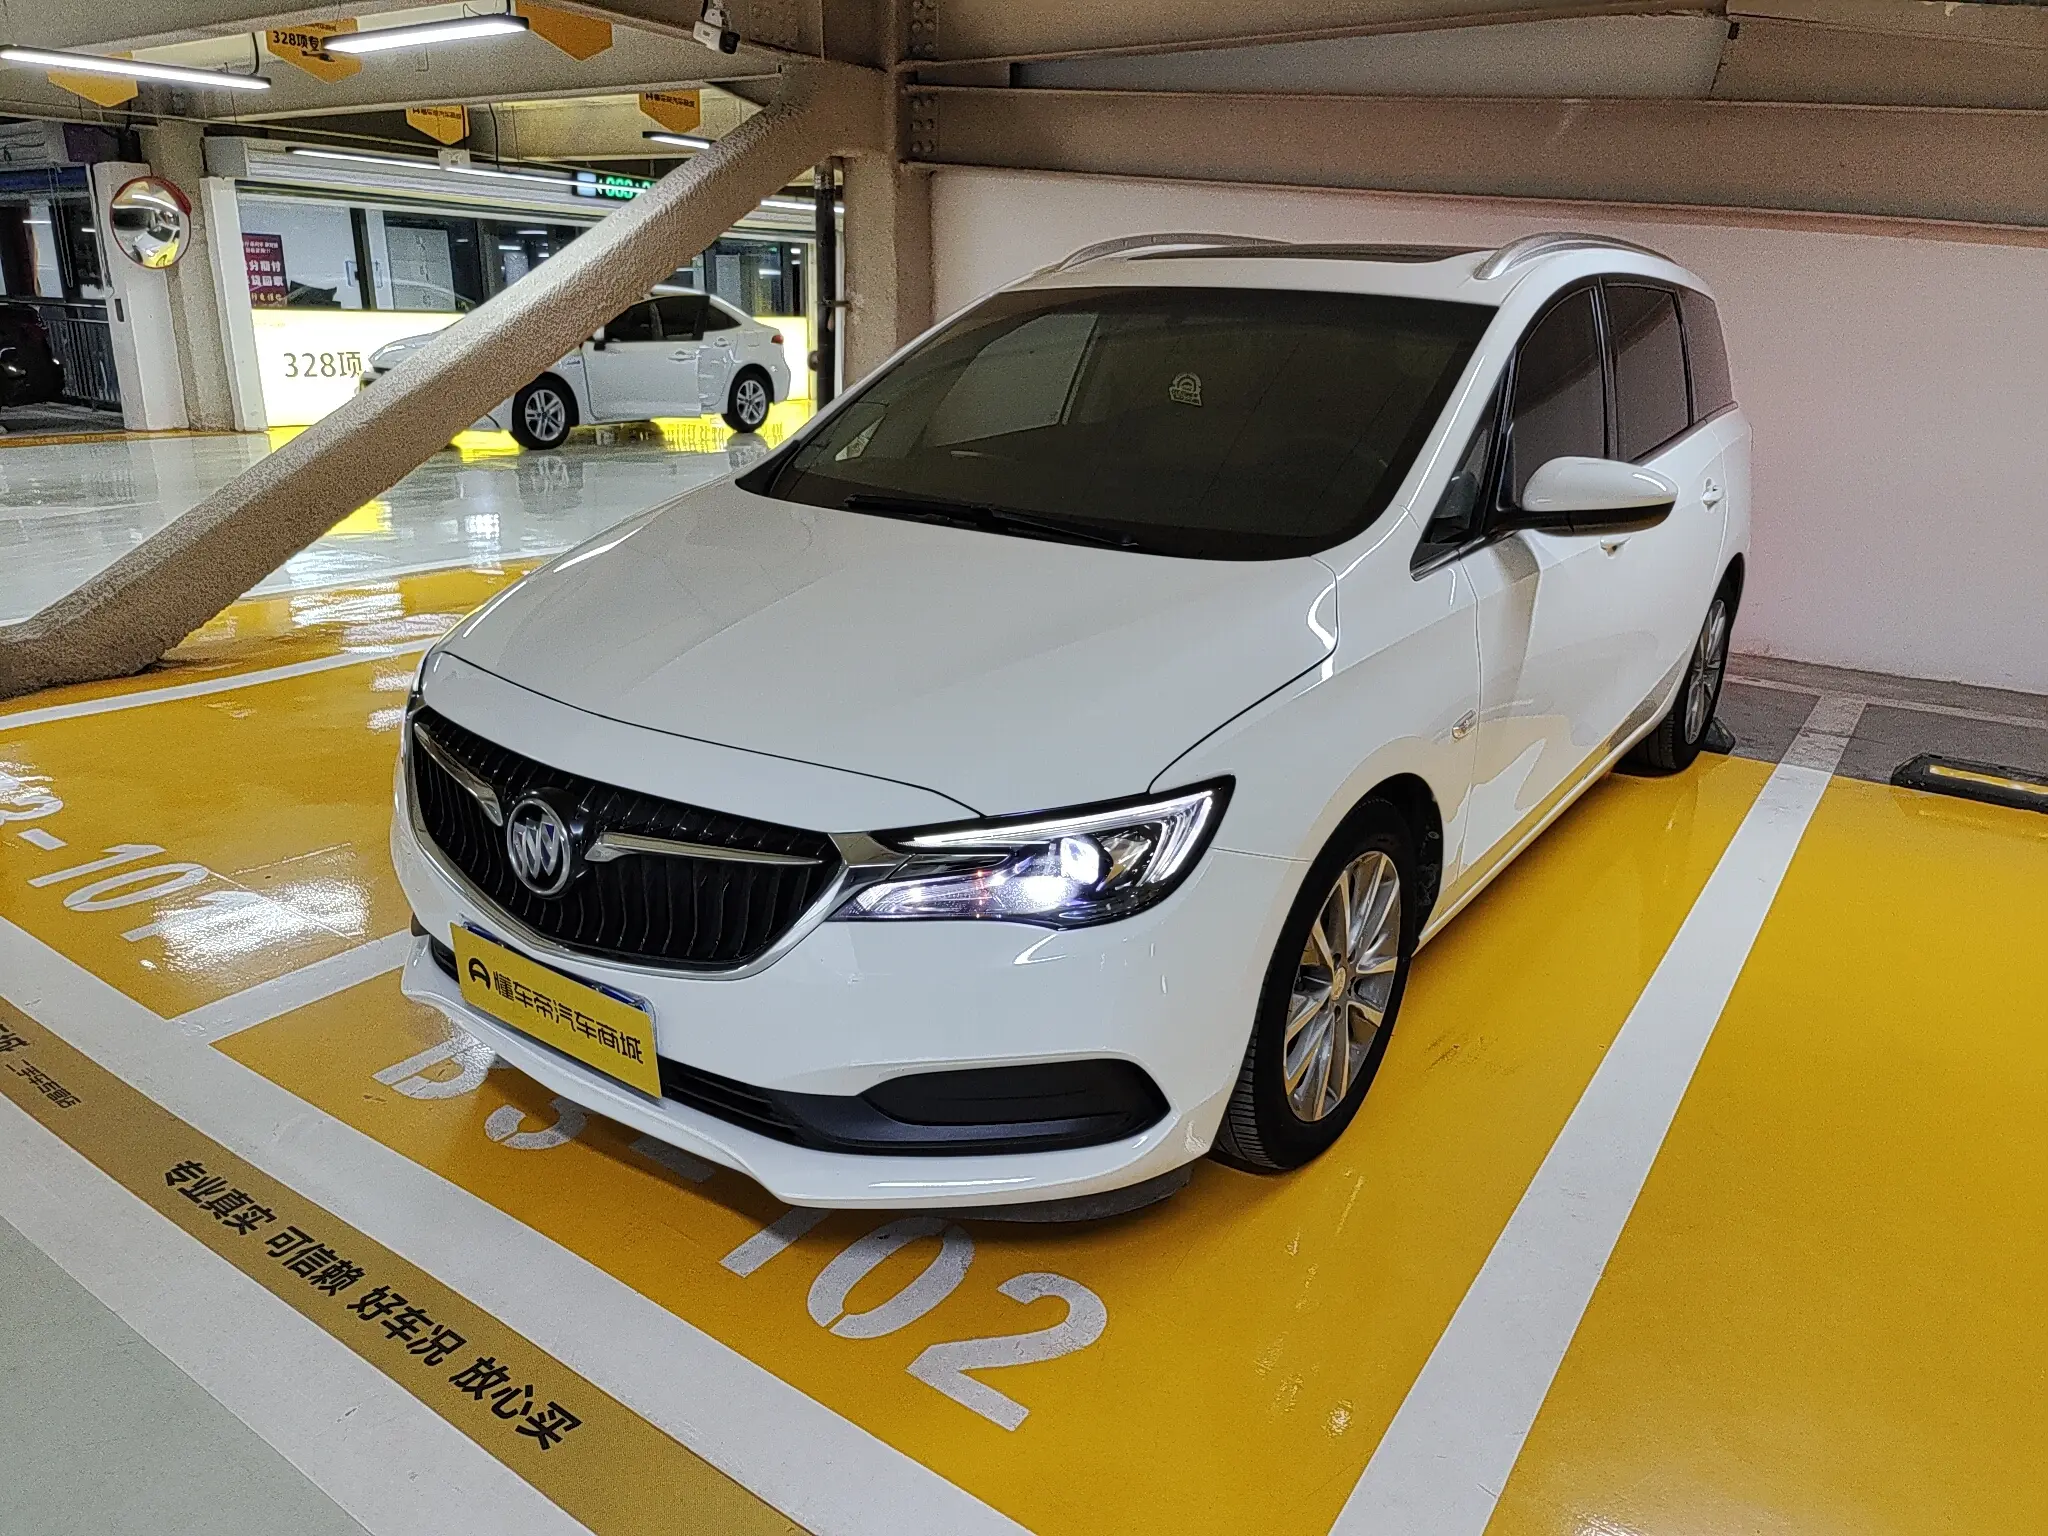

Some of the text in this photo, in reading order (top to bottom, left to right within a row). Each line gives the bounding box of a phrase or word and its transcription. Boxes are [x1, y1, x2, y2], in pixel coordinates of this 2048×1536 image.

[245, 259, 281, 273] 分期付
[283, 351, 363, 378] 328项
[493, 970, 644, 1065] 懂车帝汽车商城
[164, 1160, 583, 1451] 专业真实 可信赖 好车况 放心买
